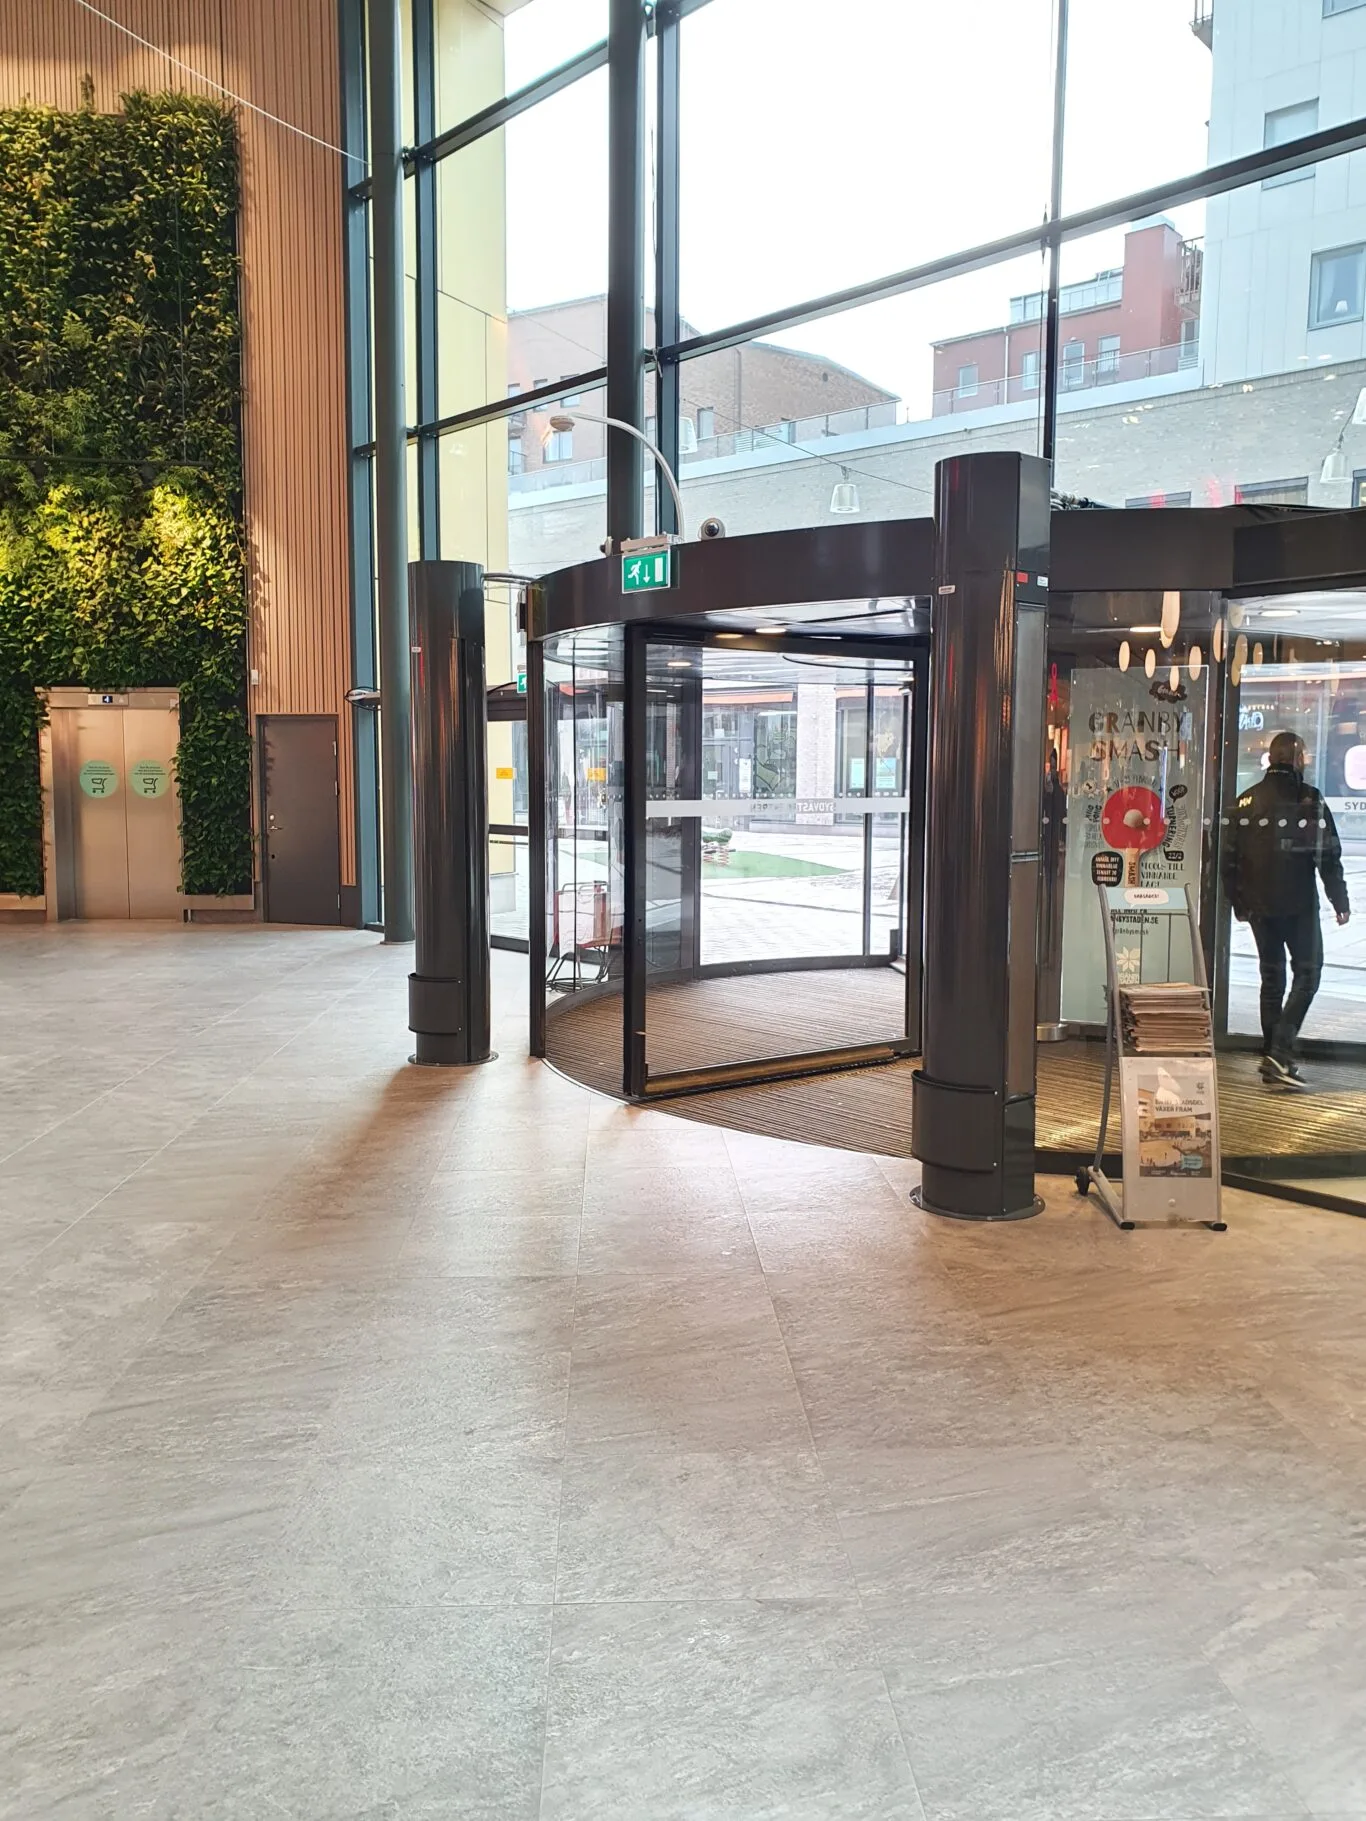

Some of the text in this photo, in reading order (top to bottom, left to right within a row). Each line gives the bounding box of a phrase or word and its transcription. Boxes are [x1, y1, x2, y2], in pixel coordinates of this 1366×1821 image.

[1090, 740, 1180, 762] SMASH
[1163, 805, 1177, 848] TURNERING
[1168, 863, 1185, 871] TILL
